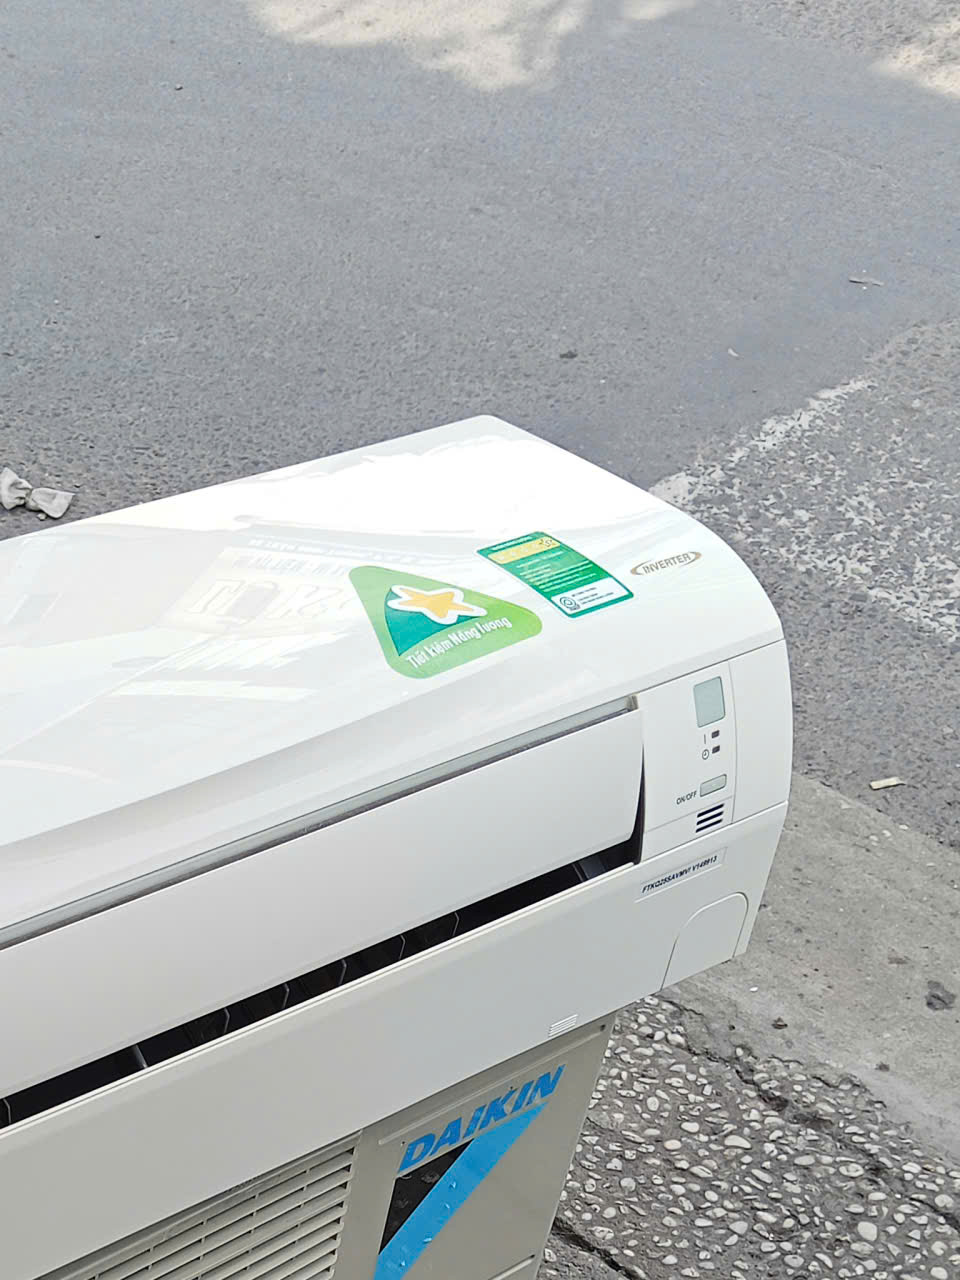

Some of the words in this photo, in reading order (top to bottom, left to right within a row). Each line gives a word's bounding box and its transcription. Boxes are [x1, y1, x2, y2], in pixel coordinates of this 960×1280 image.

[642, 553, 691, 574] INVERTER
[676, 790, 698, 805] ON/OFF
[399, 1064, 566, 1174] DAIKIN
